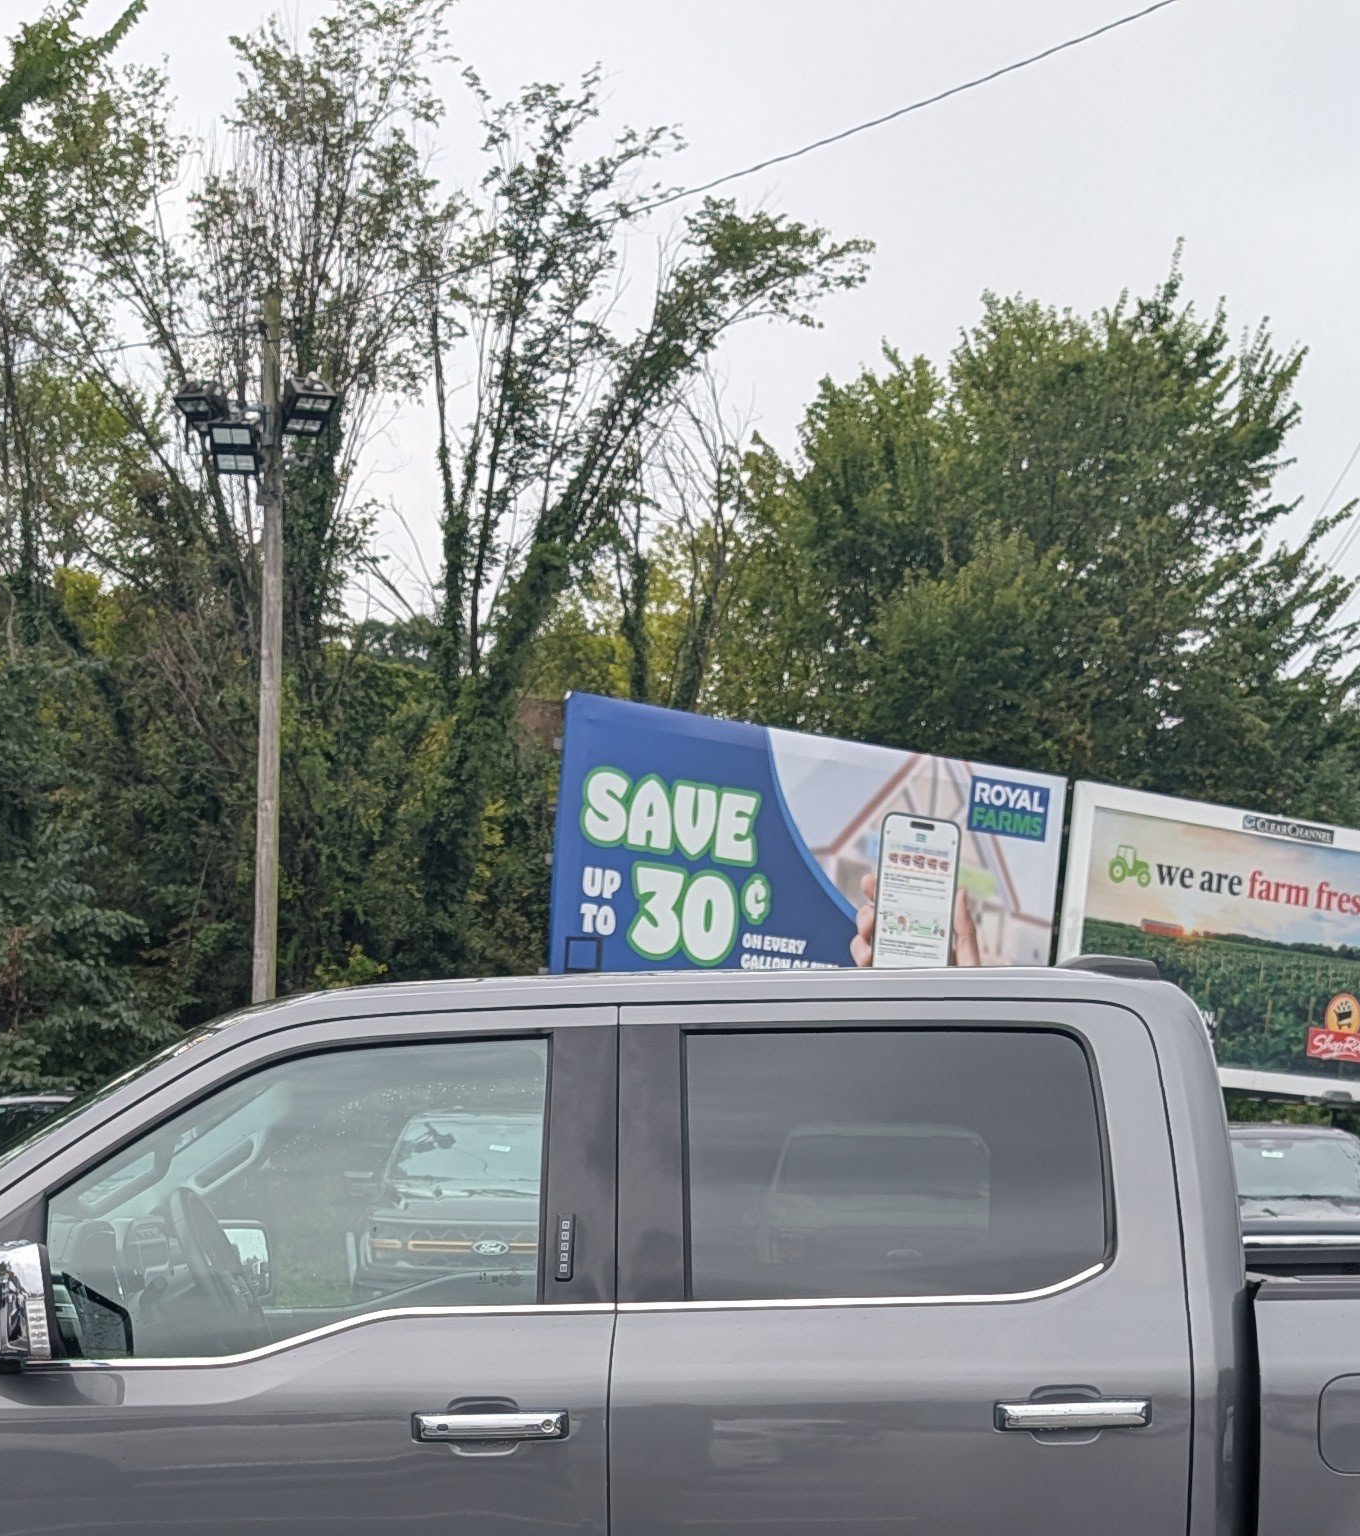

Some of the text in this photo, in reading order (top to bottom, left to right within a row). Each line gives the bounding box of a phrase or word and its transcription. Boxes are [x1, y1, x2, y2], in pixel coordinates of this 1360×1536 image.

[974, 781, 1045, 813] ROYAL
[581, 767, 760, 866] SAVE
[972, 806, 1042, 836] FARMS
[582, 866, 622, 899] UP
[1156, 862, 1194, 889] we
[1199, 869, 1243, 897] are
[1246, 869, 1310, 908] farm
[580, 903, 617, 936] TO
[763, 935, 807, 955] EVERY
